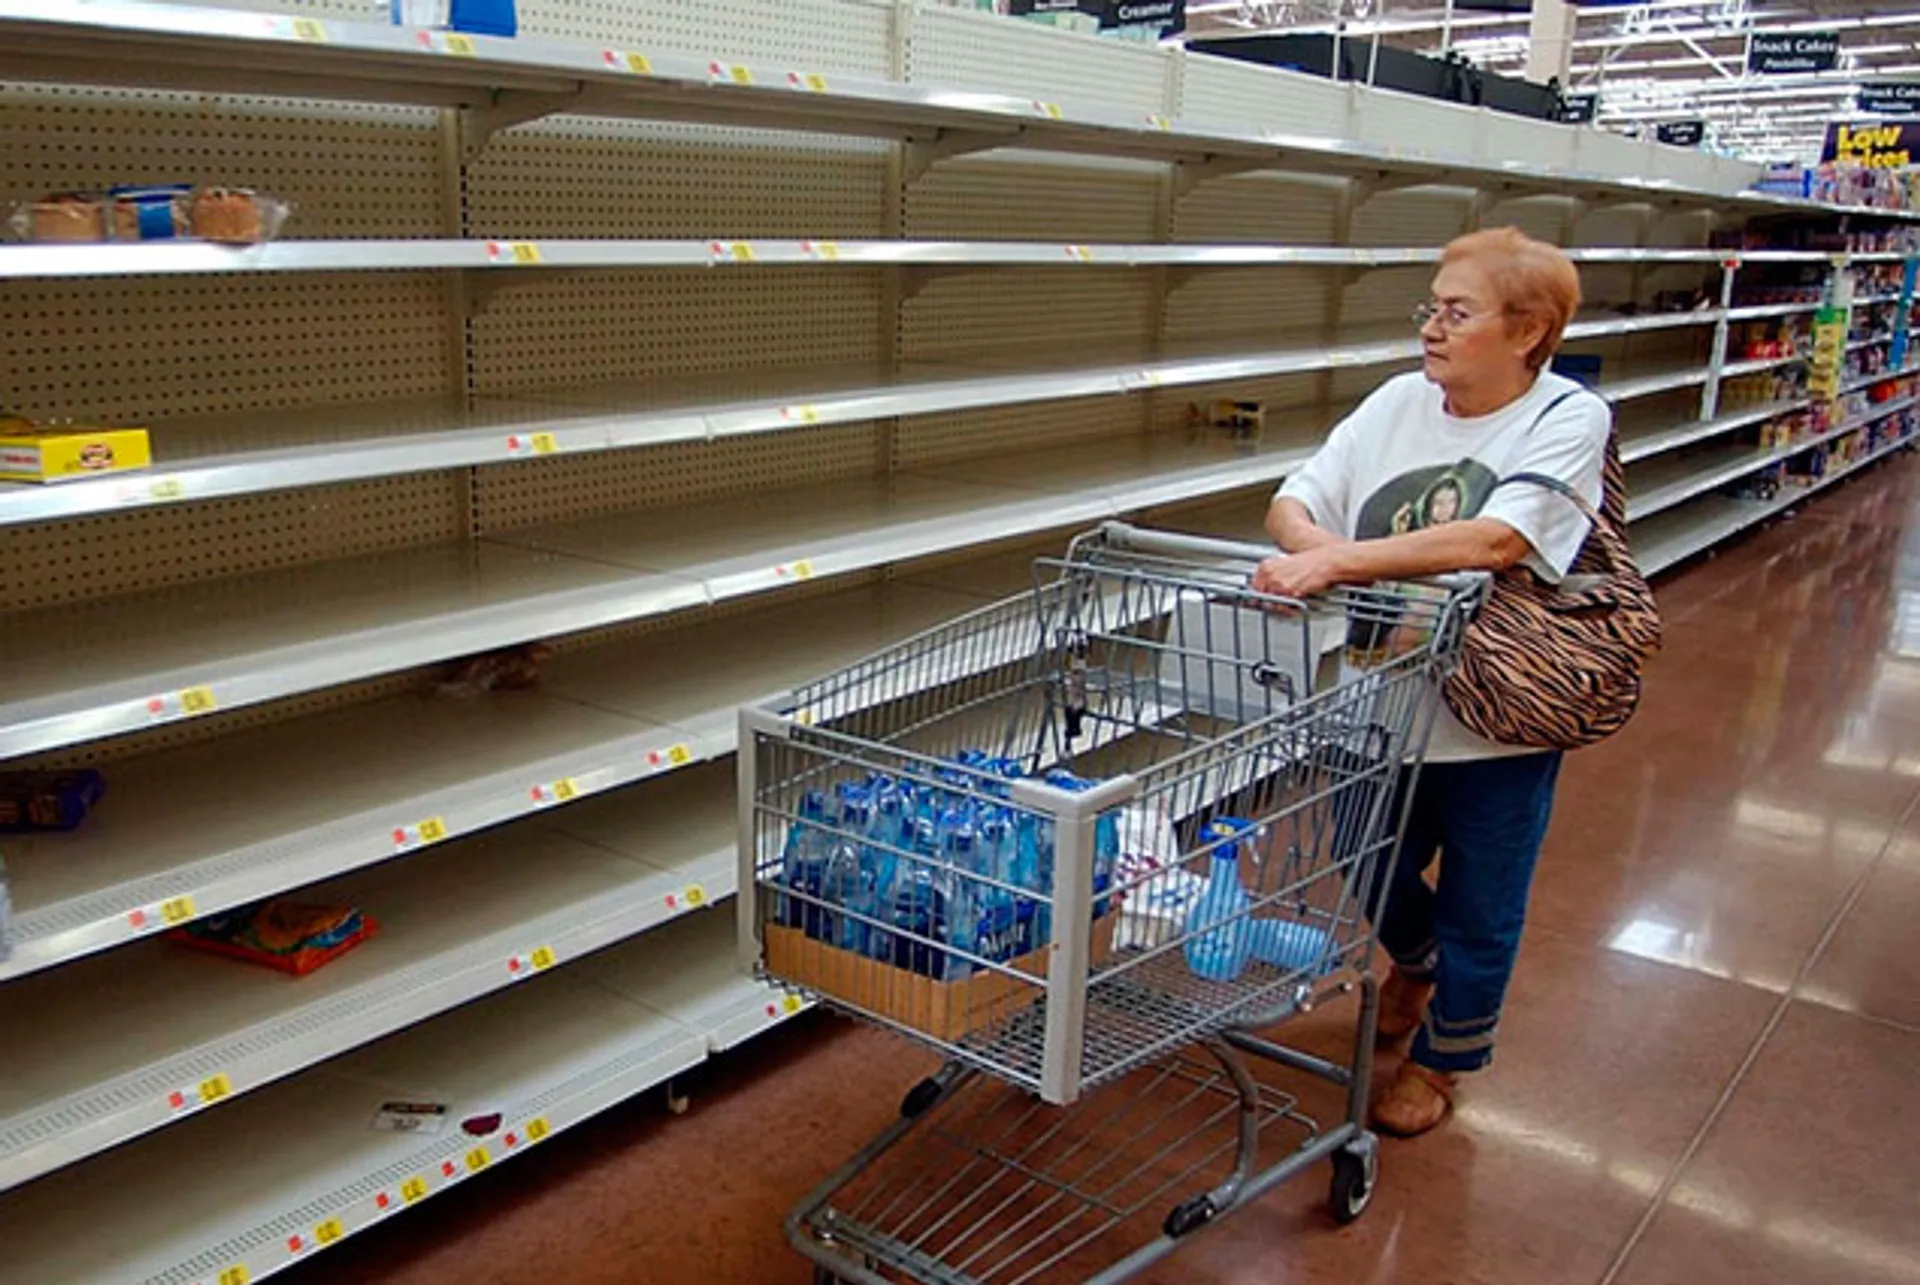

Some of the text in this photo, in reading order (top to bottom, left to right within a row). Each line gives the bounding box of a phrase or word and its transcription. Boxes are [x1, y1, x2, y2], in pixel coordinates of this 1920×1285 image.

[1753, 38, 1834, 53] Snack Cakes
[1838, 125, 1903, 149] Low
